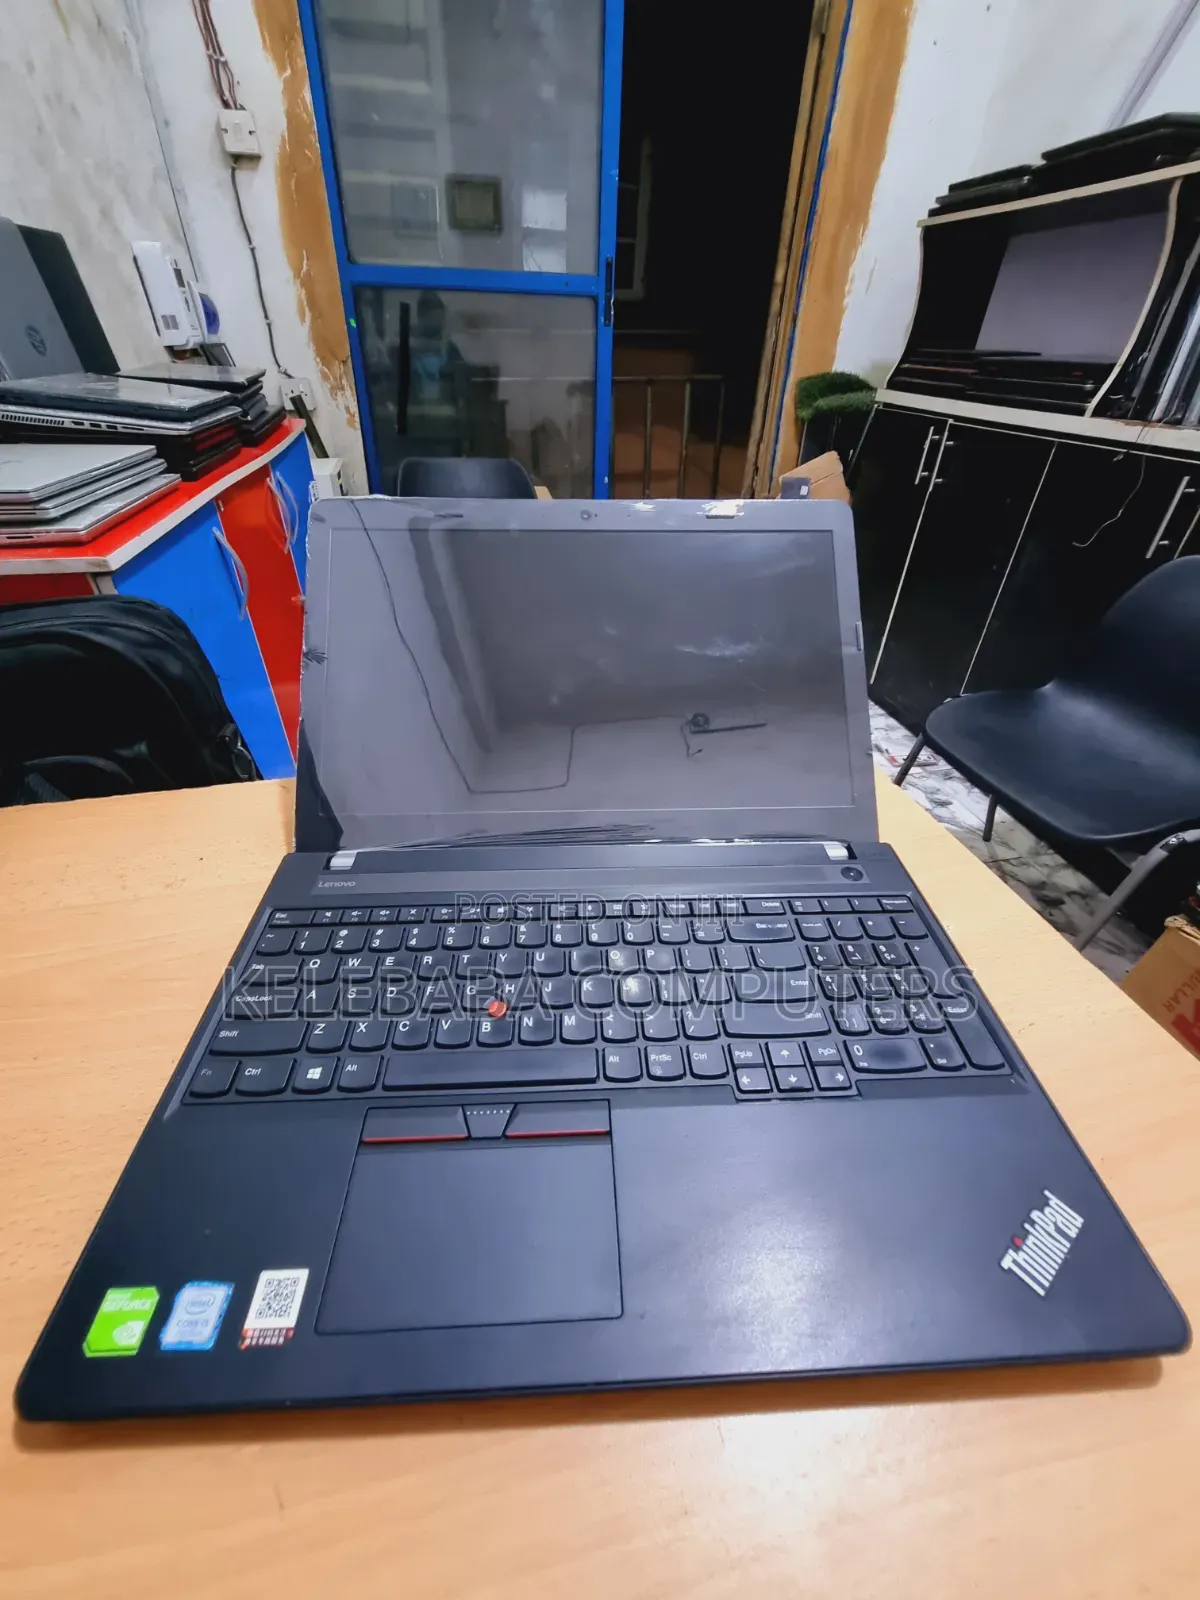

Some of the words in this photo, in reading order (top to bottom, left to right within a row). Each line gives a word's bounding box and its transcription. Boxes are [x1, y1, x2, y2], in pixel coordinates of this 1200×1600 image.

[446, 937, 454, 945] 5
[482, 936, 490, 944] 6
[519, 935, 526, 943] 7
[555, 934, 562, 942] 8
[591, 933, 598, 941] 9
[300, 941, 306, 949] 1
[335, 940, 344, 948] 2
[372, 938, 380, 947] 3
[409, 938, 417, 946] 4
[499, 953, 508, 962] Y
[536, 952, 545, 961] U
[610, 950, 621, 960] O
[646, 949, 655, 958] P
[348, 958, 362, 967] W
[385, 956, 395, 966] E
[423, 956, 433, 965] R
[462, 954, 470, 964] T
[309, 959, 321, 969] Q
[426, 986, 435, 995] F
[466, 985, 476, 995] G
[505, 984, 514, 993] H
[545, 983, 551, 992] J
[584, 981, 593, 991] K
[306, 989, 316, 999] A
[347, 989, 356, 998] S
[387, 988, 397, 997] D
[523, 1017, 533, 1027] N
[565, 1015, 576, 1025] M
[314, 1024, 325, 1034] Z
[357, 1022, 368, 1032] X
[400, 1021, 410, 1031] C
[442, 1020, 451, 1030] V
[482, 1021, 491, 1032] B
[818, 1048, 836, 1056] PgDn
[245, 1067, 261, 1076] Ctrl
[1000, 1189, 1084, 1297] ThinkPad
